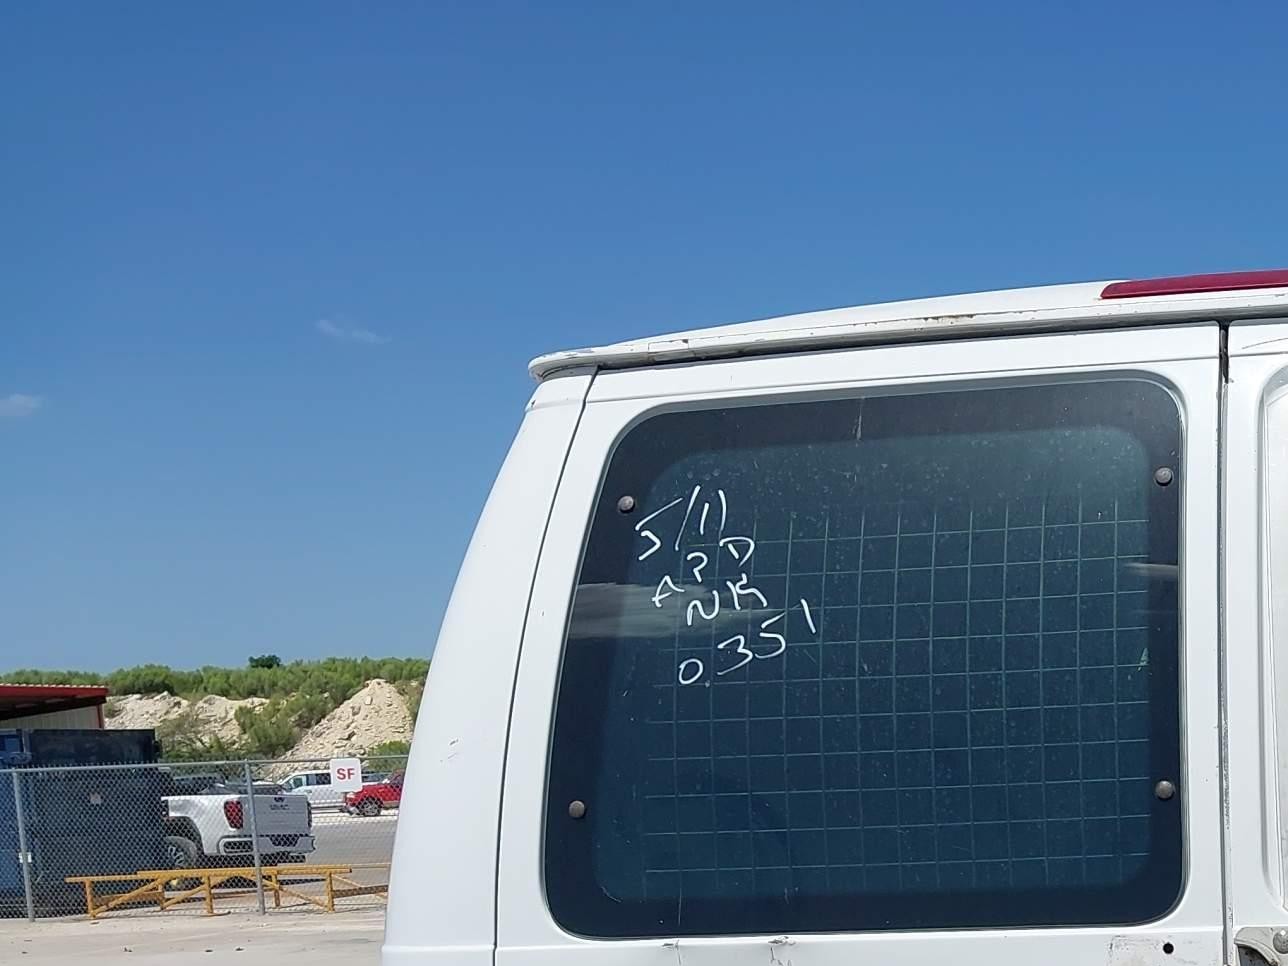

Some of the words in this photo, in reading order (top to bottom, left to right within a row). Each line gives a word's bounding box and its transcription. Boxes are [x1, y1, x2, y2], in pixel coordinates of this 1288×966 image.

[635, 485, 727, 561] 5/11
[678, 598, 816, 685] 0351
[336, 768, 355, 781] SF
